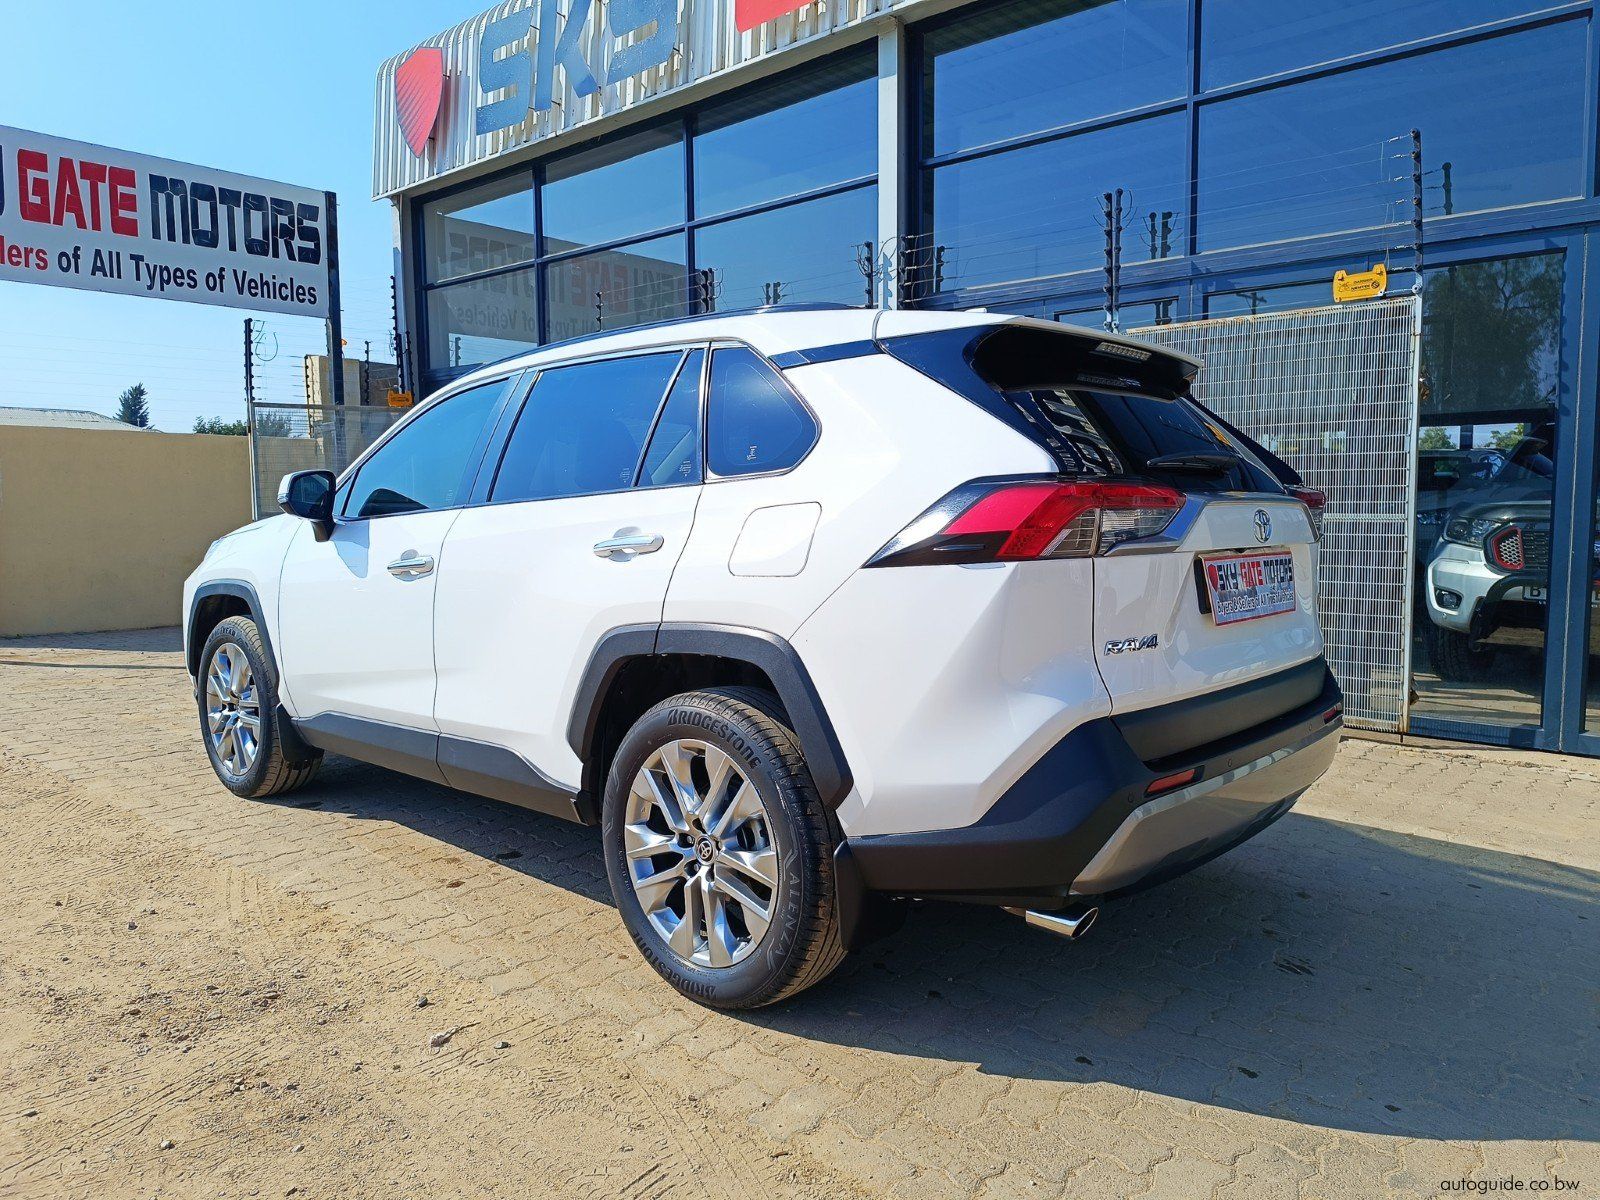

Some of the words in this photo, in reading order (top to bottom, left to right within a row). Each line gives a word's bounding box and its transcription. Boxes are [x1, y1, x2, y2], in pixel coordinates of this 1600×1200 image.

[17, 148, 139, 237] GATE
[149, 173, 322, 265] MOTORS
[57, 246, 81, 273] of
[90, 248, 122, 279] All
[130, 254, 198, 292] Types
[205, 267, 225, 294] of
[233, 268, 318, 305] Vehicles
[1216, 563, 1239, 591] SKY
[1240, 560, 1264, 588] GATE
[1103, 633, 1159, 656] RAV4
[666, 708, 762, 770] BRIDGESTONE
[775, 871, 801, 956] ALENZA
